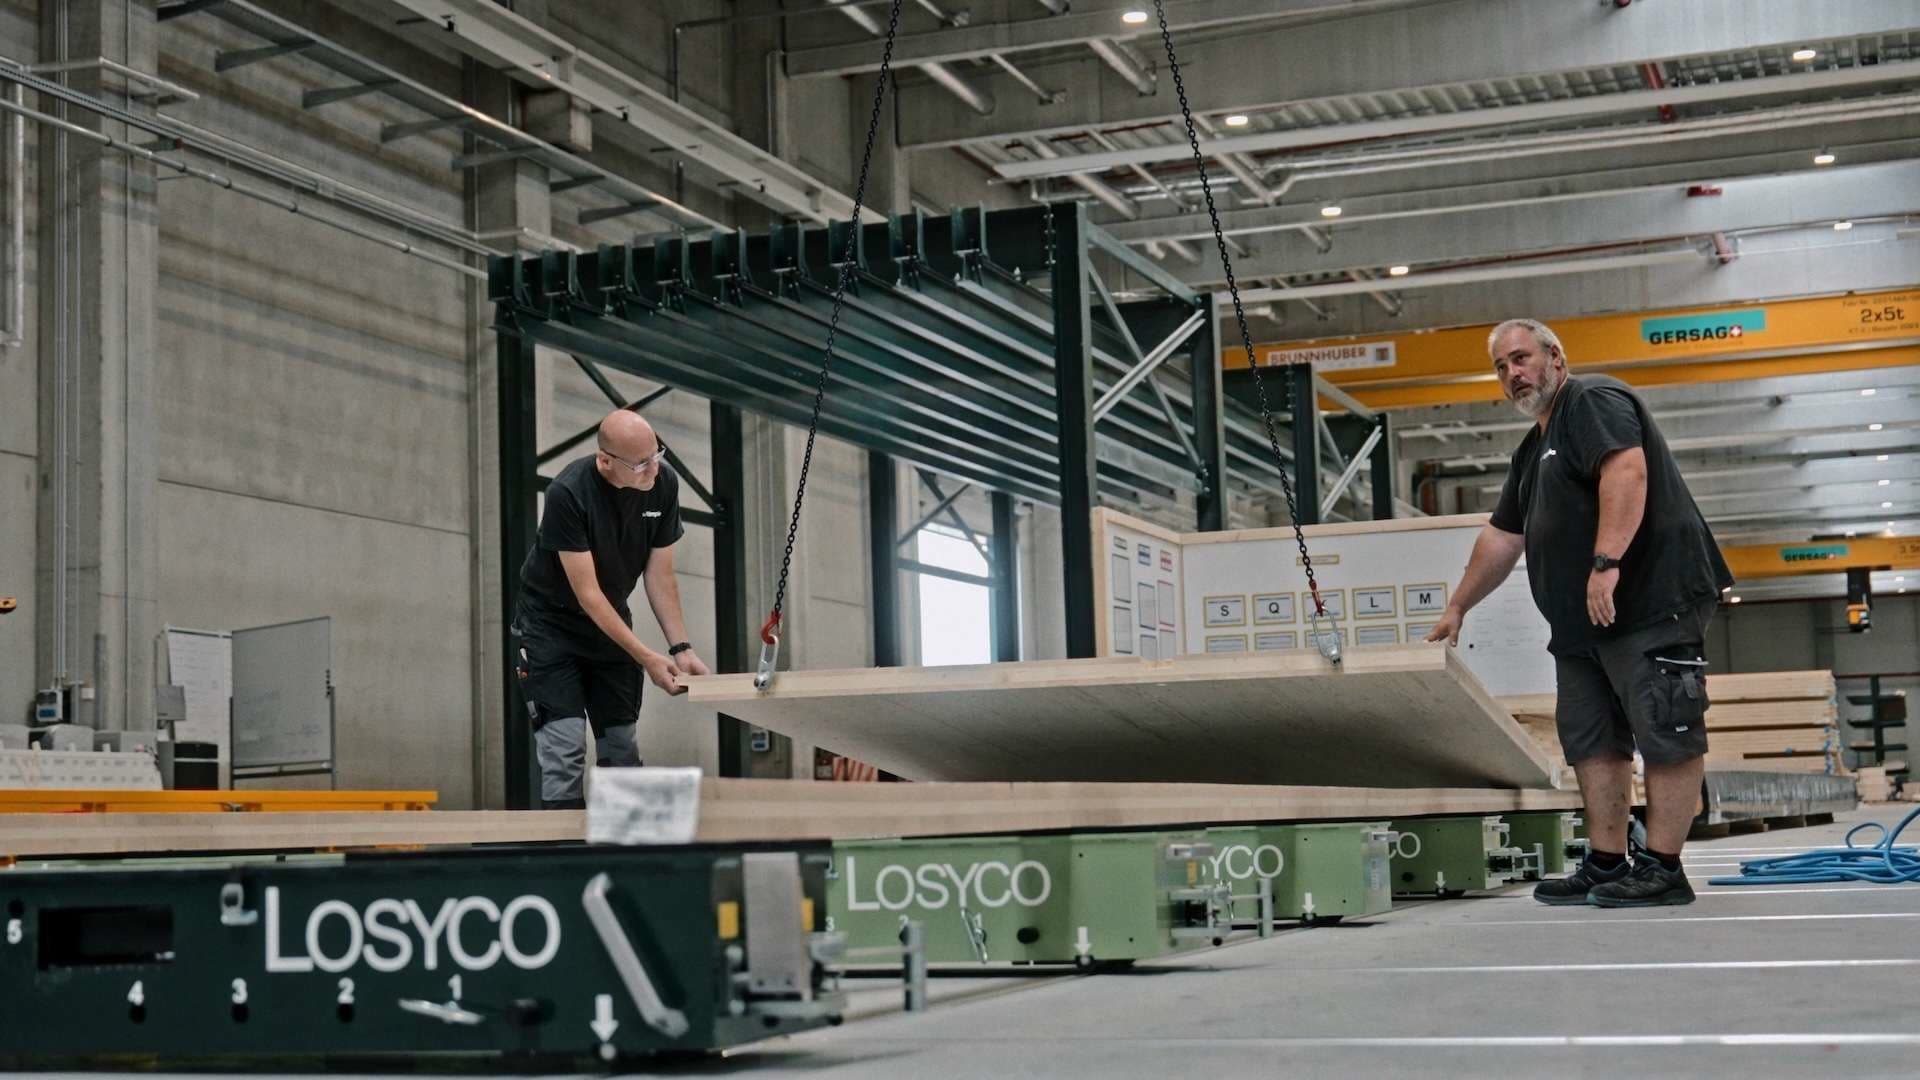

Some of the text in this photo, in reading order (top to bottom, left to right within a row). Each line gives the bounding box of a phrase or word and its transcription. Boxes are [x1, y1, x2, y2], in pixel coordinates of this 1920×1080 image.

[1861, 306, 1905, 323] 2x5t
[1649, 326, 1728, 345] GERSAG
[1271, 347, 1367, 363] BRUNNHUBER
[1268, 602, 1280, 614] Q
[1370, 597, 1379, 608] L
[1419, 593, 1432, 604] M
[1220, 604, 1230, 617] S
[1201, 844, 1284, 879] YCO
[846, 856, 1051, 910] LOSYCO
[7, 919, 22, 944] 5
[265, 886, 561, 972] LOSYCO
[825, 916, 835, 932] 3
[128, 980, 144, 1005] 4
[232, 978, 248, 1004] 3
[337, 977, 354, 1004] 2
[448, 974, 462, 1000] 1
